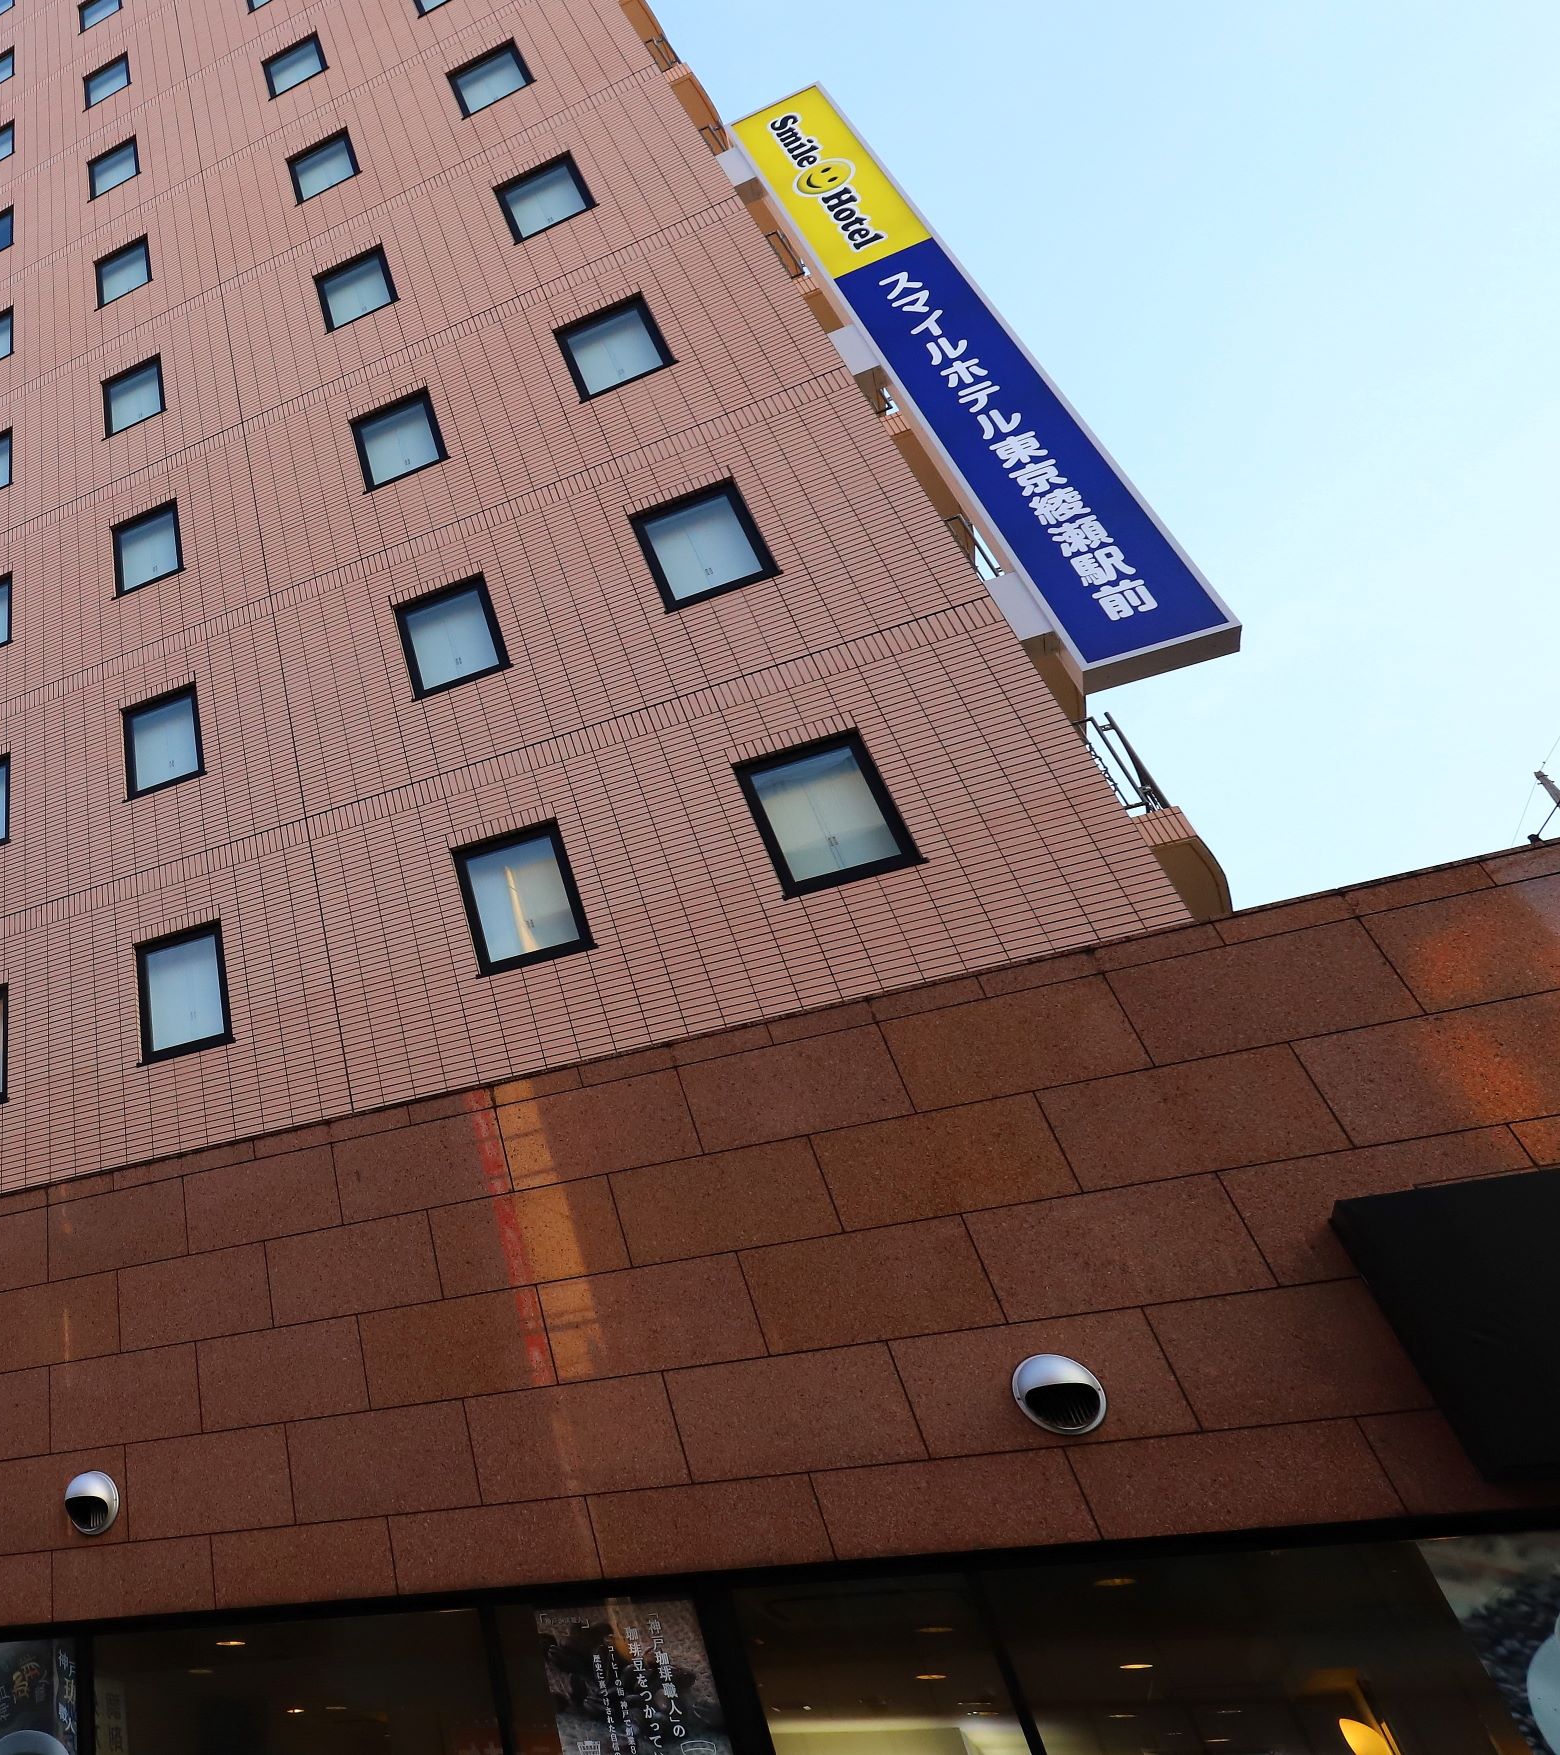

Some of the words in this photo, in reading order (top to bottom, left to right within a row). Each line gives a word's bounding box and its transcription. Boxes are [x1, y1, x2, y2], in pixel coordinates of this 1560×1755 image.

[770, 114, 819, 168] Smile
[821, 186, 884, 251] Hotel
[879, 271, 1158, 621] スマイルホテル東京綾瀬駅前
[648, 1612, 686, 1738] 「神戸珈琲職人」の
